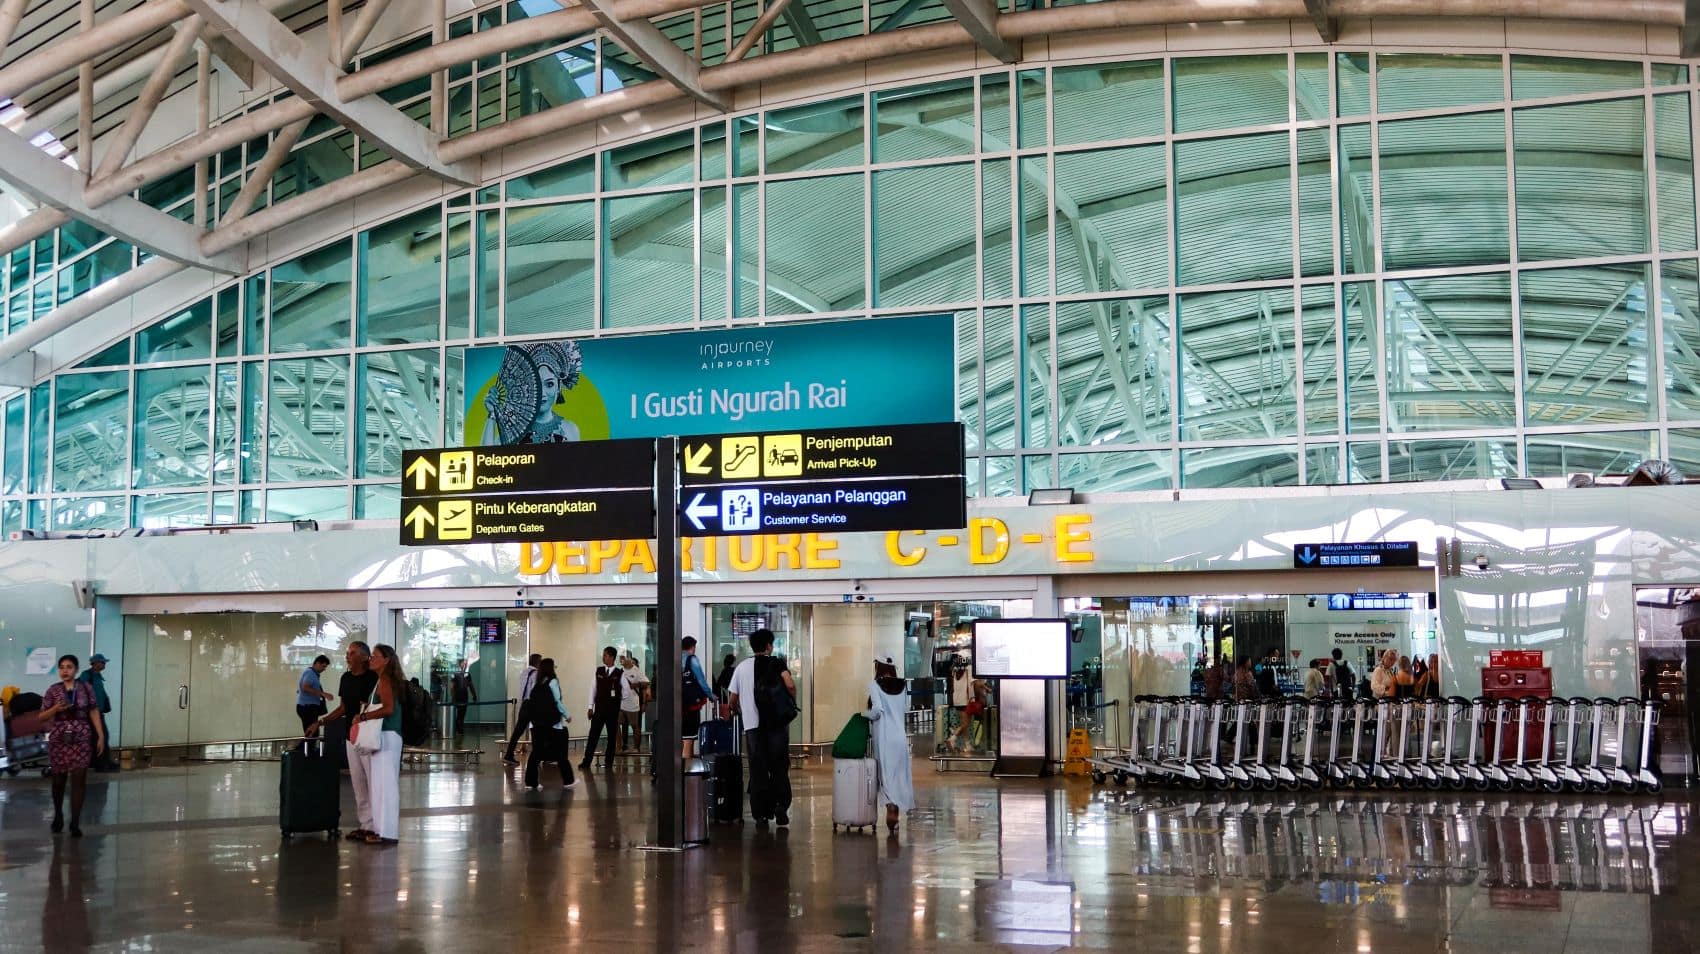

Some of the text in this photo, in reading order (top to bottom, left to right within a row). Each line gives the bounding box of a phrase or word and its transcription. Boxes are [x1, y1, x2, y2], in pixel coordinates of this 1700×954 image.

[701, 358, 771, 370] AIRPORTS
[631, 379, 847, 421] I Gusti Ngurah Rai
[806, 435, 893, 451] Penjemputan
[477, 453, 535, 468] Pelaporan
[807, 457, 877, 469] Arrival Pick-Up
[477, 475, 513, 485] Check-in
[763, 488, 907, 508] Pelayanan Pelanggan
[475, 500, 597, 516] Pintu Keberangkatan
[764, 513, 847, 525] Customer Service
[476, 523, 545, 534] Departure Gates
[519, 532, 840, 575] DEPATURE
[1380, 631, 1396, 639] Only
